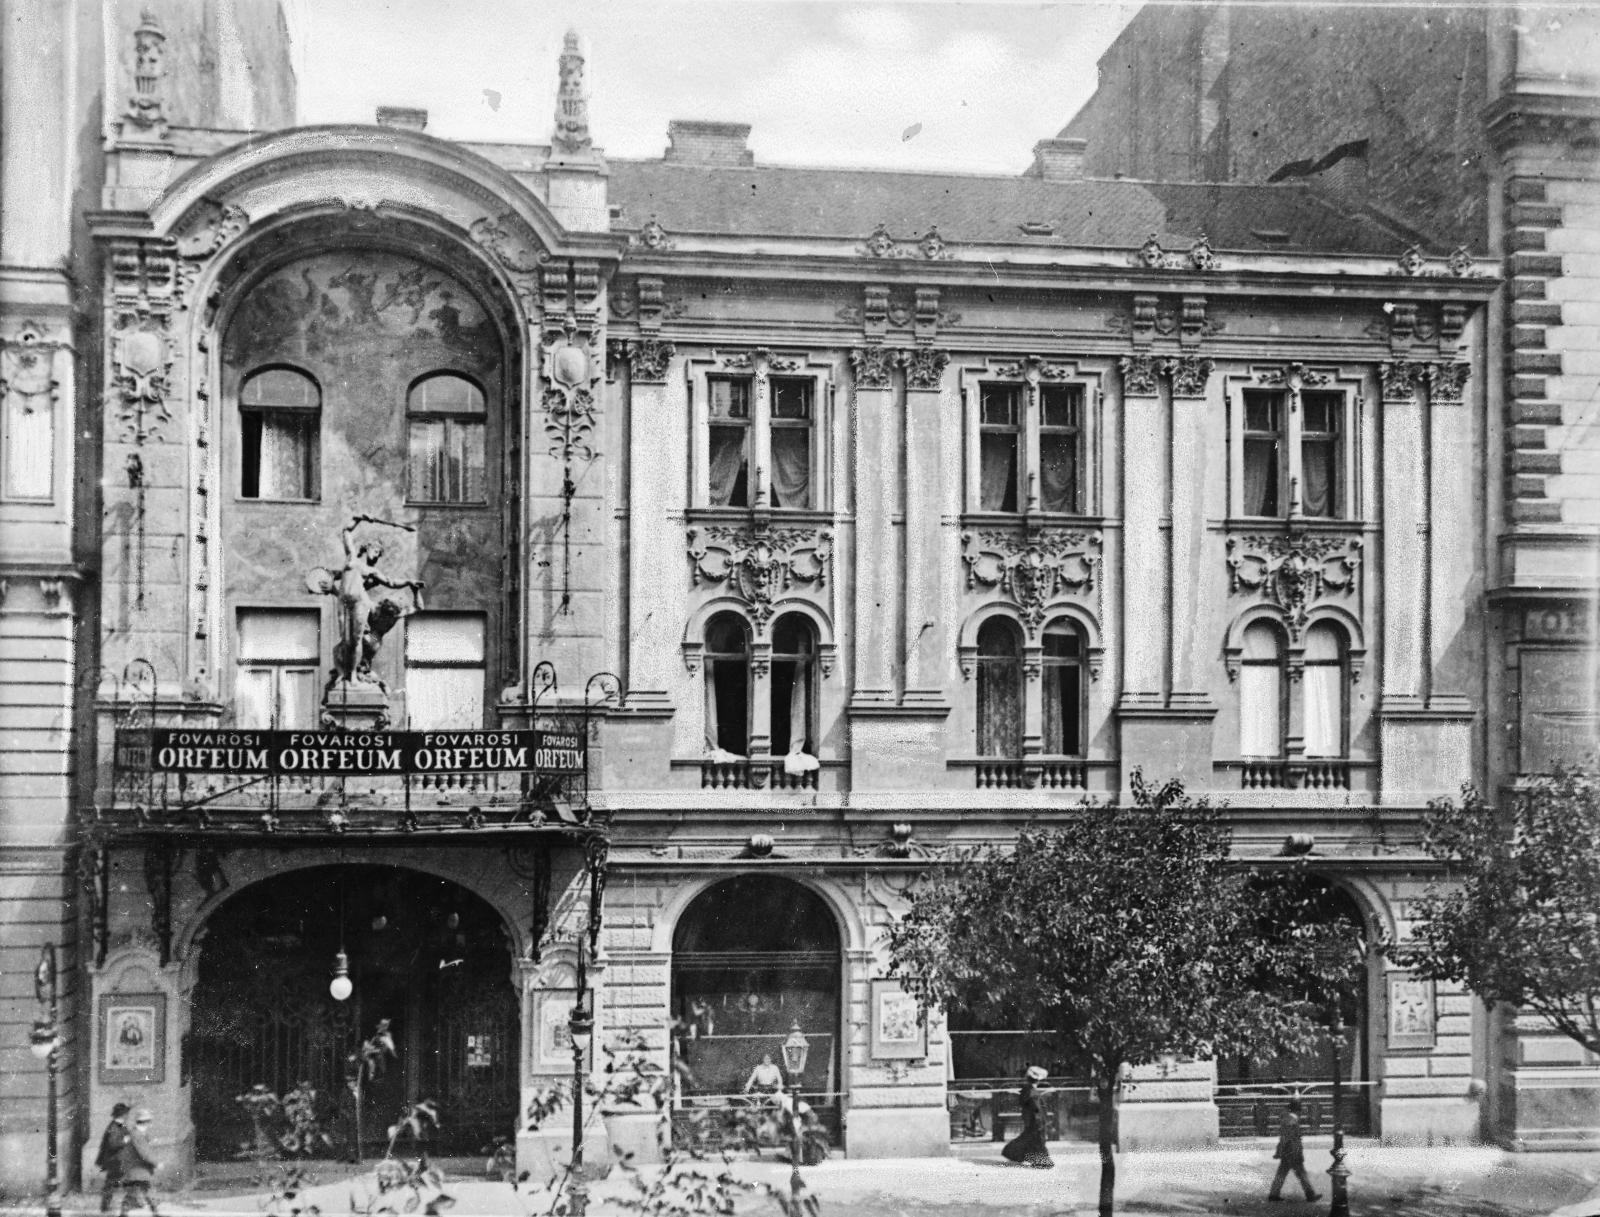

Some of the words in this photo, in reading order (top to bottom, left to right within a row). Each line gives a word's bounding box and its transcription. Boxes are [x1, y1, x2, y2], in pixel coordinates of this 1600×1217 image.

[290, 734, 392, 747] FOVAROSI
[424, 734, 518, 746] FOVAROSI
[542, 734, 578, 748] FOVAROSI
[158, 747, 269, 769] ORFEUM
[279, 748, 402, 770] ORFEUM
[414, 747, 528, 769] ORFEUM
[535, 748, 584, 769] ORFEUM
